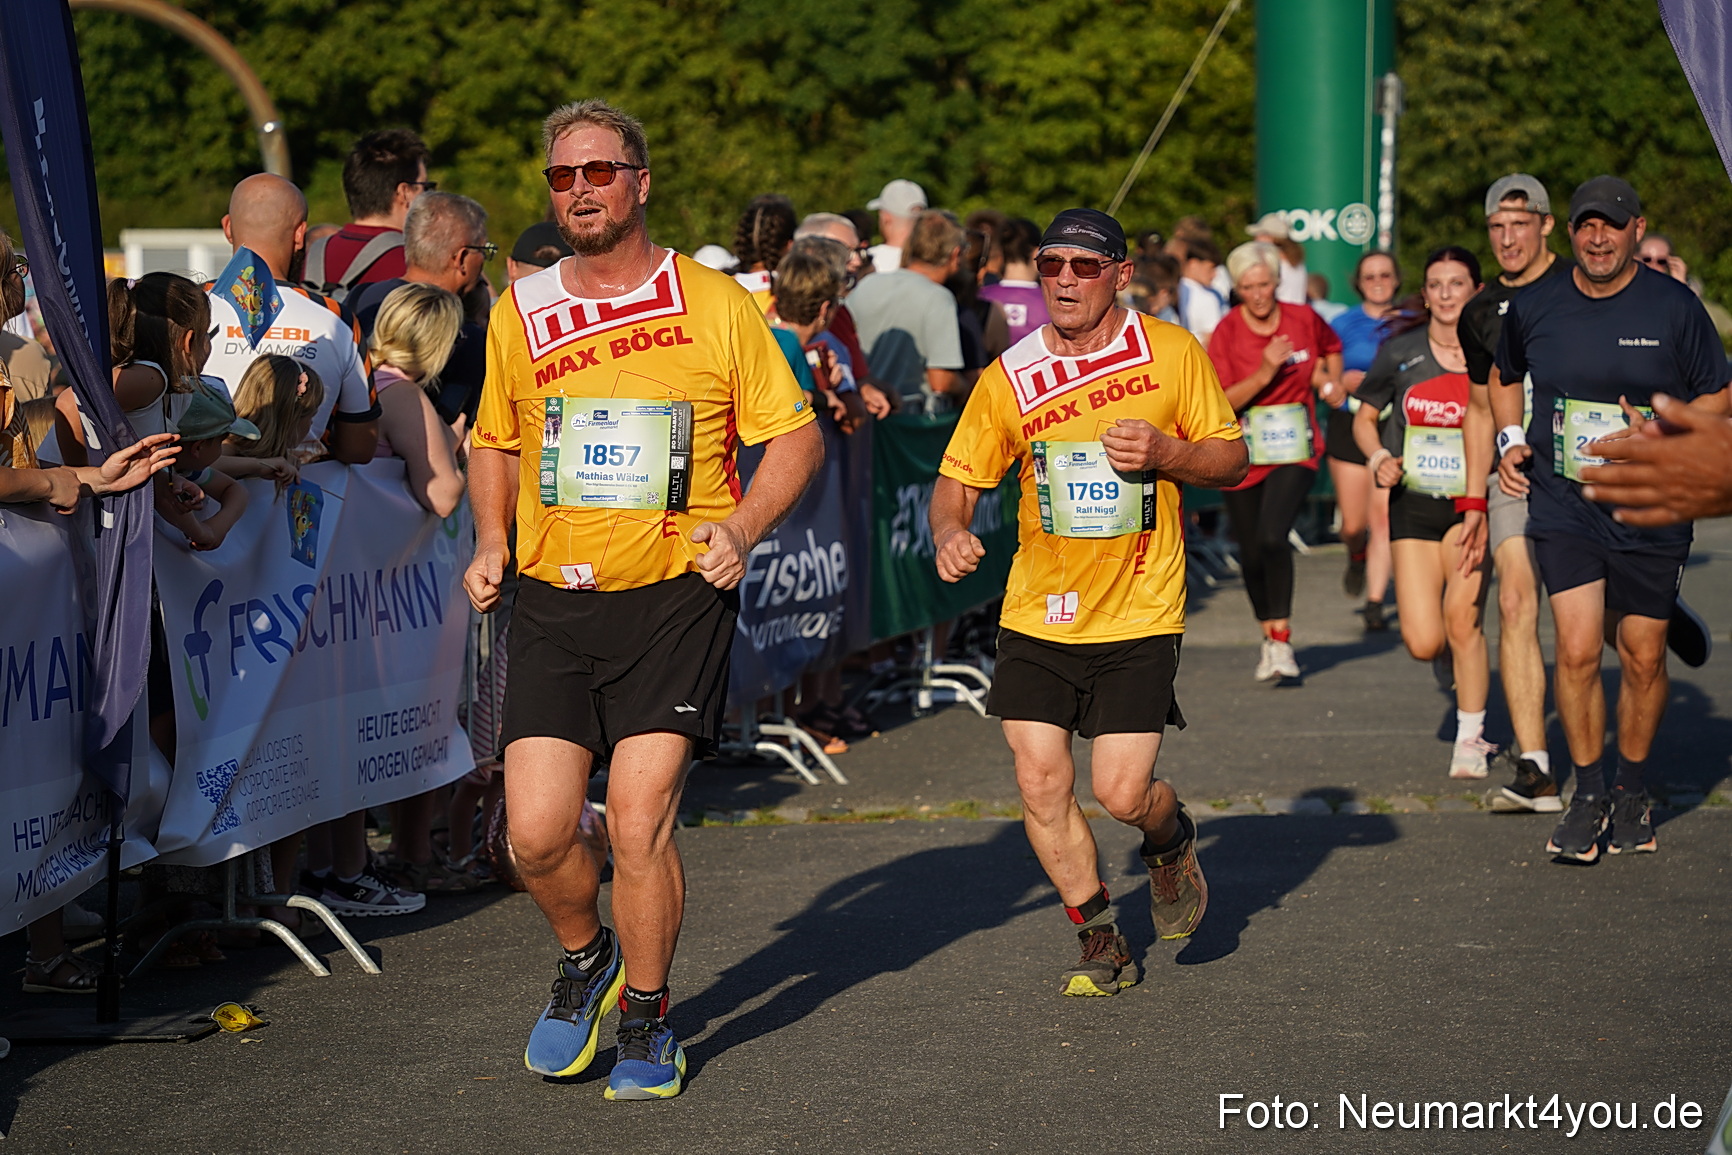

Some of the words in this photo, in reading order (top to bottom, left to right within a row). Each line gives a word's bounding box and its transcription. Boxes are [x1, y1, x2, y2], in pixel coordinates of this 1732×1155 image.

[1276, 208, 1338, 243] OK
[227, 326, 317, 343] KEBL
[225, 342, 317, 360] DYNAMICS
[535, 346, 601, 389] MAX
[609, 326, 693, 359] BÖGL
[1022, 400, 1082, 440] MAX
[1088, 374, 1160, 410] BÖGL
[588, 420, 619, 428] Firmenlauf
[583, 444, 642, 467] 1857
[1417, 455, 1460, 470] 2065
[576, 471, 614, 482] Mathias
[616, 472, 649, 483] Wälzel
[670, 472, 680, 503] HILTL
[1067, 482, 1119, 500] 1769
[1076, 506, 1093, 514] Ralf
[1095, 505, 1117, 516] Niggl
[229, 561, 442, 677] FRISCHMANN
[358, 711, 398, 743] HEUTE
[262, 734, 304, 763] LOGISTICS
[238, 764, 290, 797] CORPORATE
[358, 749, 410, 785] MORGEN
[246, 789, 292, 822] CORPORATE
[15, 853, 74, 902] MORGEN
